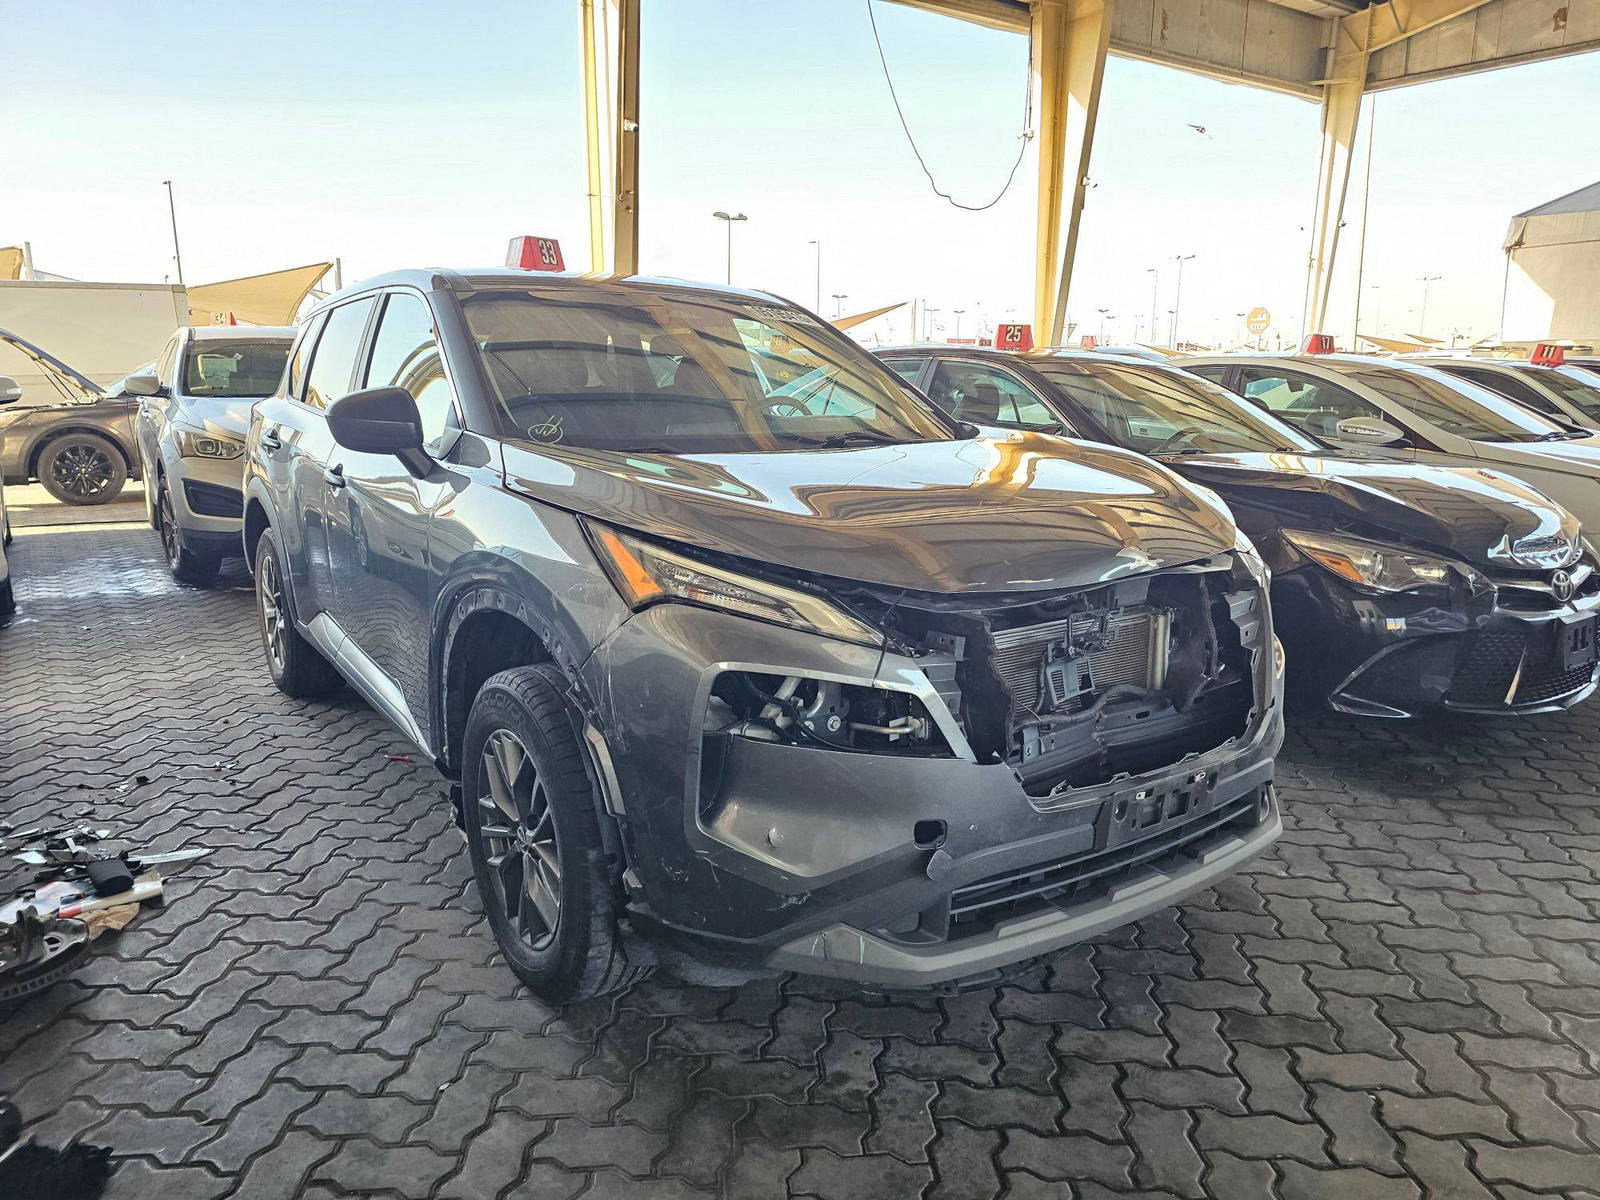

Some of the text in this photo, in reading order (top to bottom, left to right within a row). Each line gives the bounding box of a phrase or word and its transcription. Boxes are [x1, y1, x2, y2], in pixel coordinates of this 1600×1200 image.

[538, 240, 558, 264] 33
[1006, 326, 1022, 342] 25
[1543, 345, 1555, 358] 11
